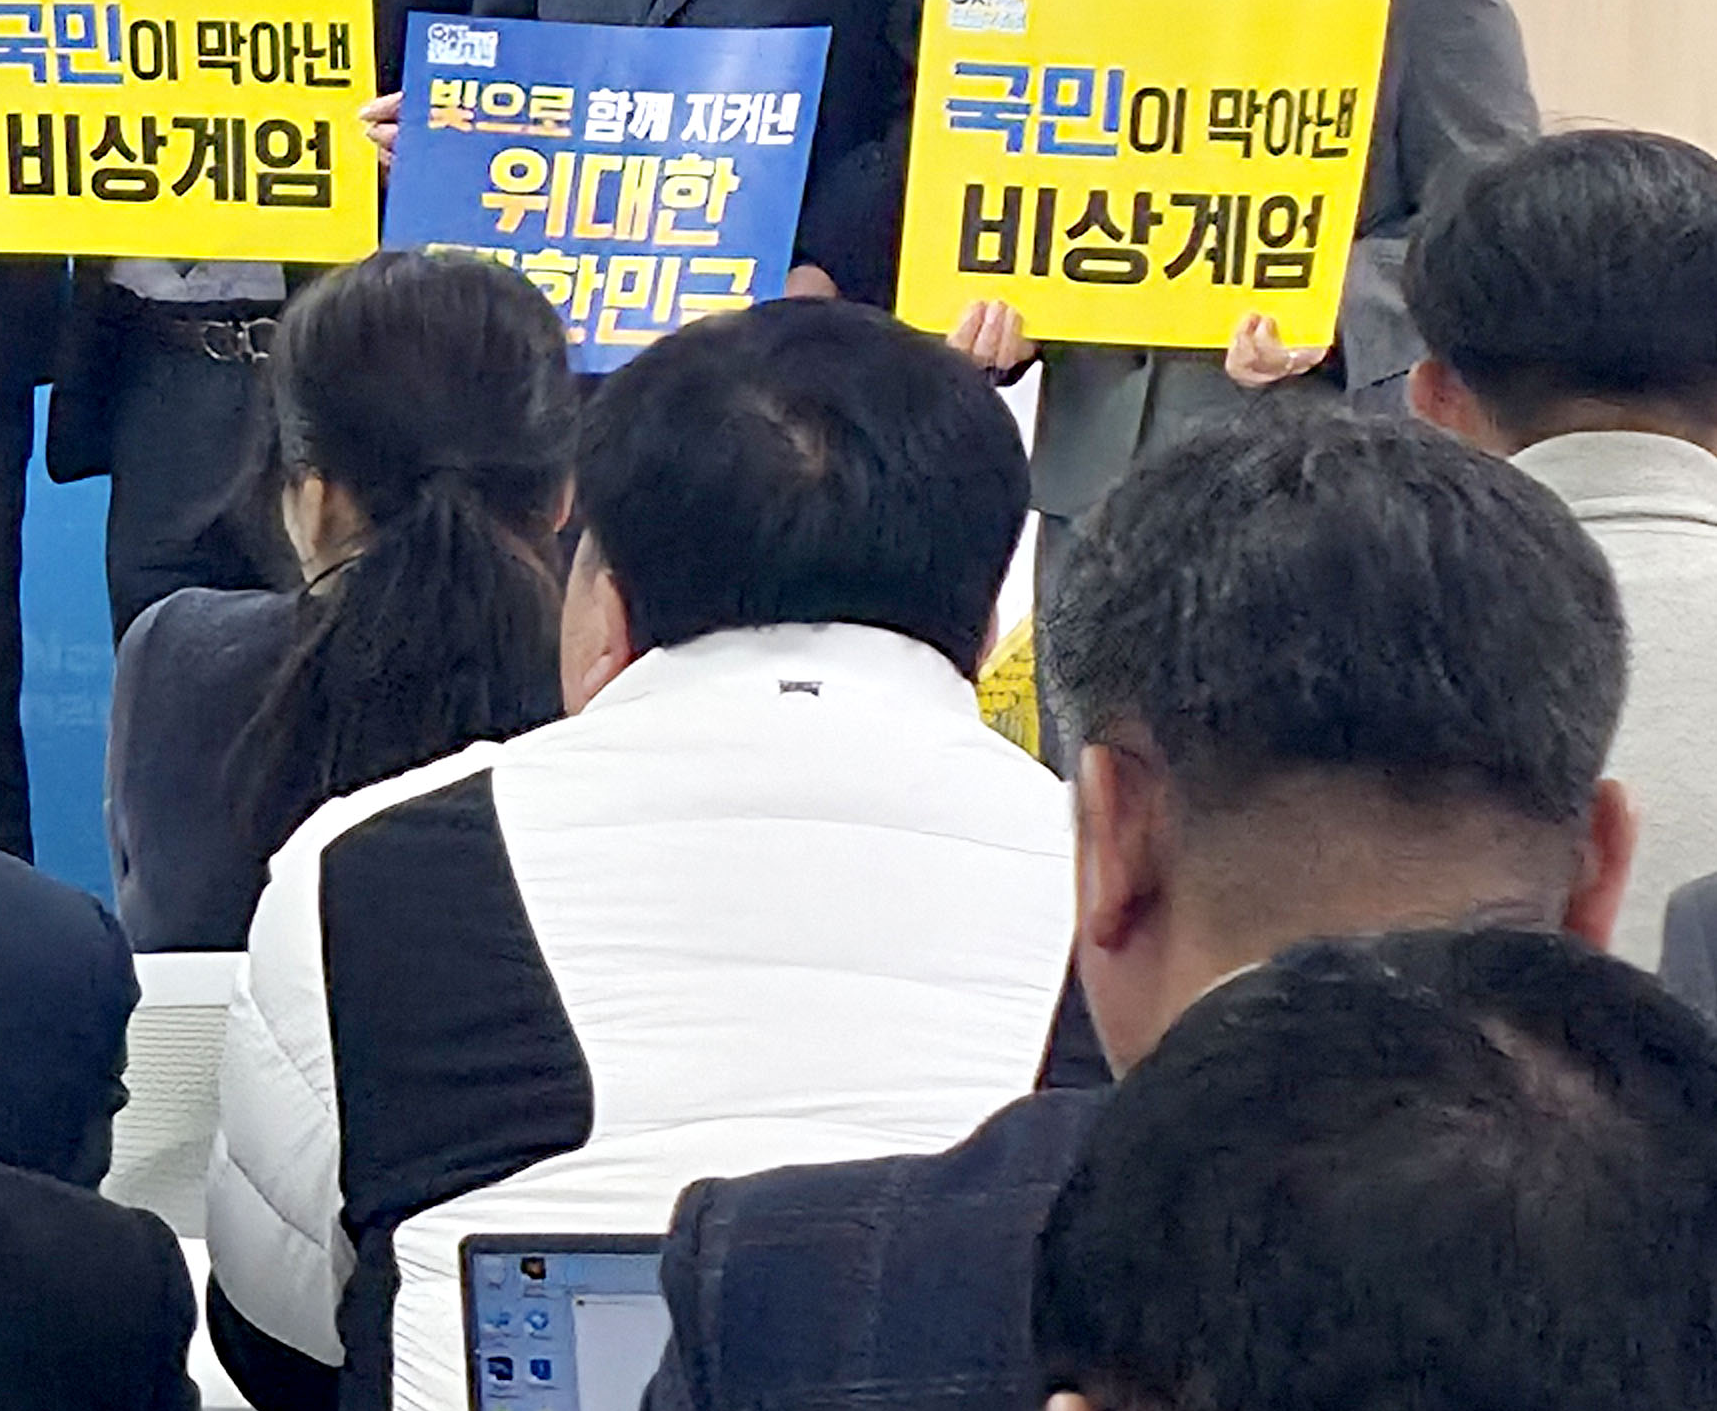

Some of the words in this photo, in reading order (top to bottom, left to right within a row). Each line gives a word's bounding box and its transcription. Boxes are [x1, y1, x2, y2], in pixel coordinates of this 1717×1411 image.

[197, 20, 352, 88] 막아낸
[427, 79, 575, 139] 빛으로
[584, 87, 675, 143] 함께
[681, 91, 802, 146] 지켜낸
[946, 62, 1188, 156] 국민이
[1208, 87, 1359, 159] 막아낸
[6, 113, 333, 209] 비상계엄
[481, 146, 740, 247] 위대한
[958, 184, 1326, 290] 비상계엄
